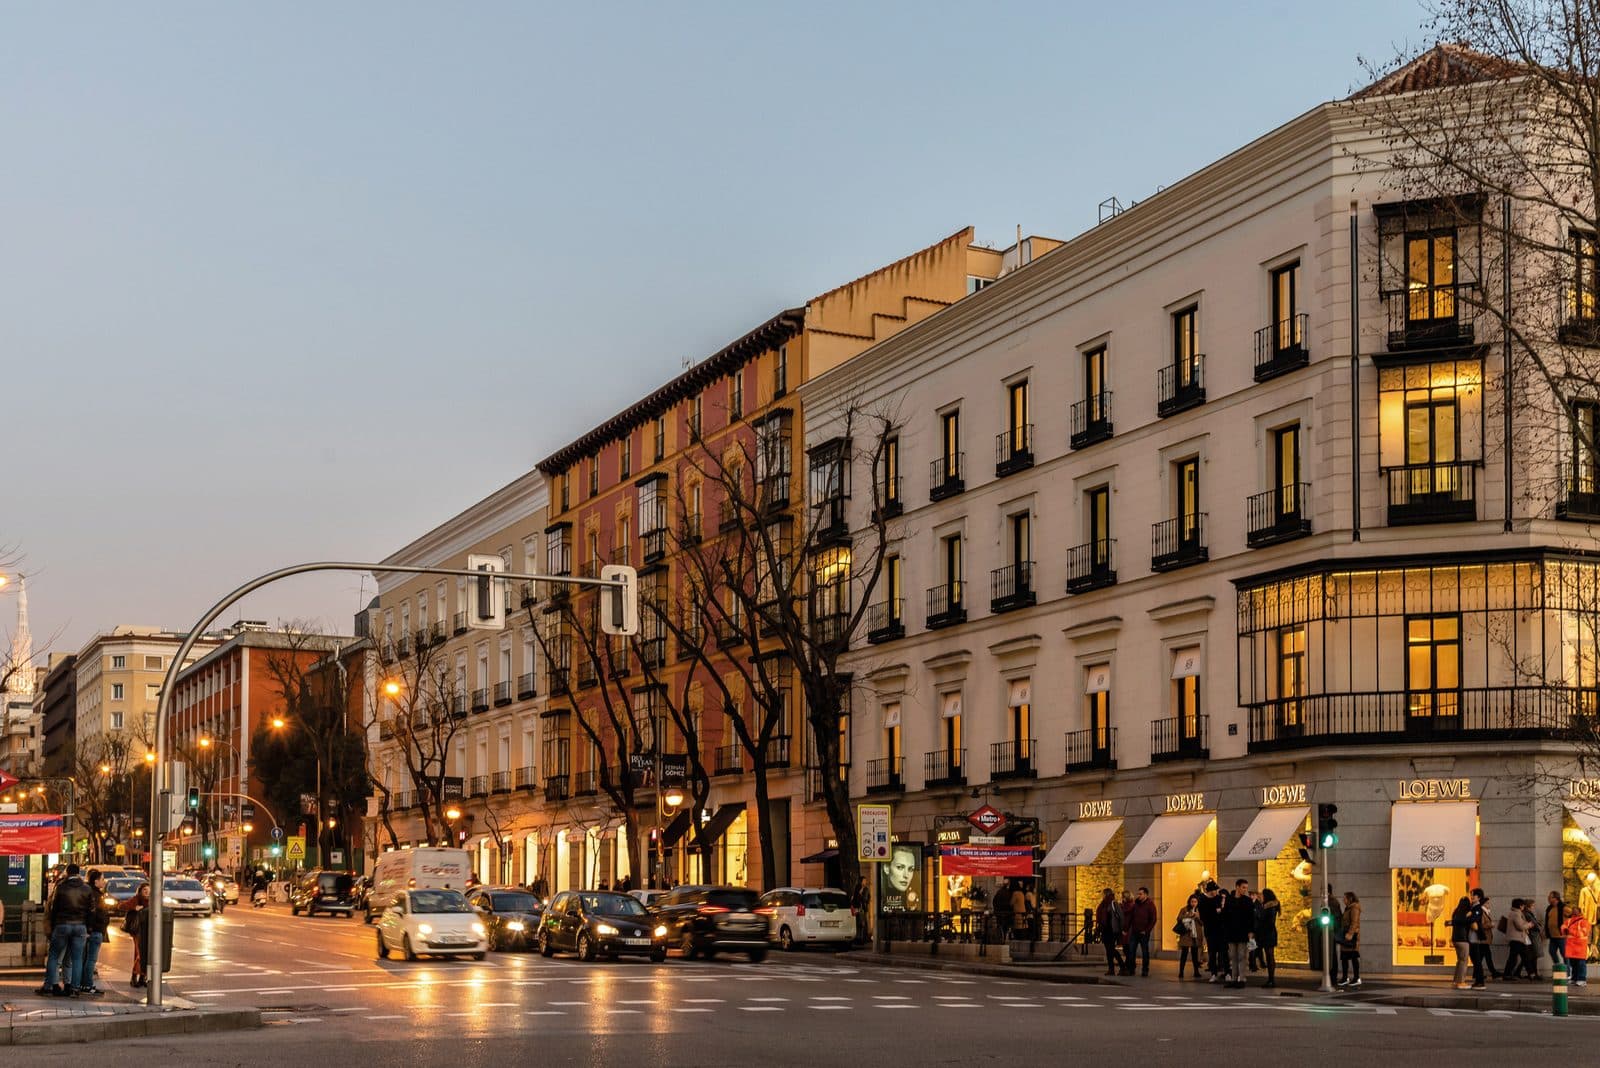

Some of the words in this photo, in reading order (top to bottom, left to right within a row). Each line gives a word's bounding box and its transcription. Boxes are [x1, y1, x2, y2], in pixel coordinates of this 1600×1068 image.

[1262, 784, 1306, 805] LOEWE
[1400, 779, 1471, 799] LOEWE
[1570, 779, 1600, 799] LOE
[1079, 800, 1112, 818] LOEWE
[1165, 793, 1204, 812] LOEWE
[980, 815, 998, 823] Metro
[938, 831, 960, 841] PRADA
